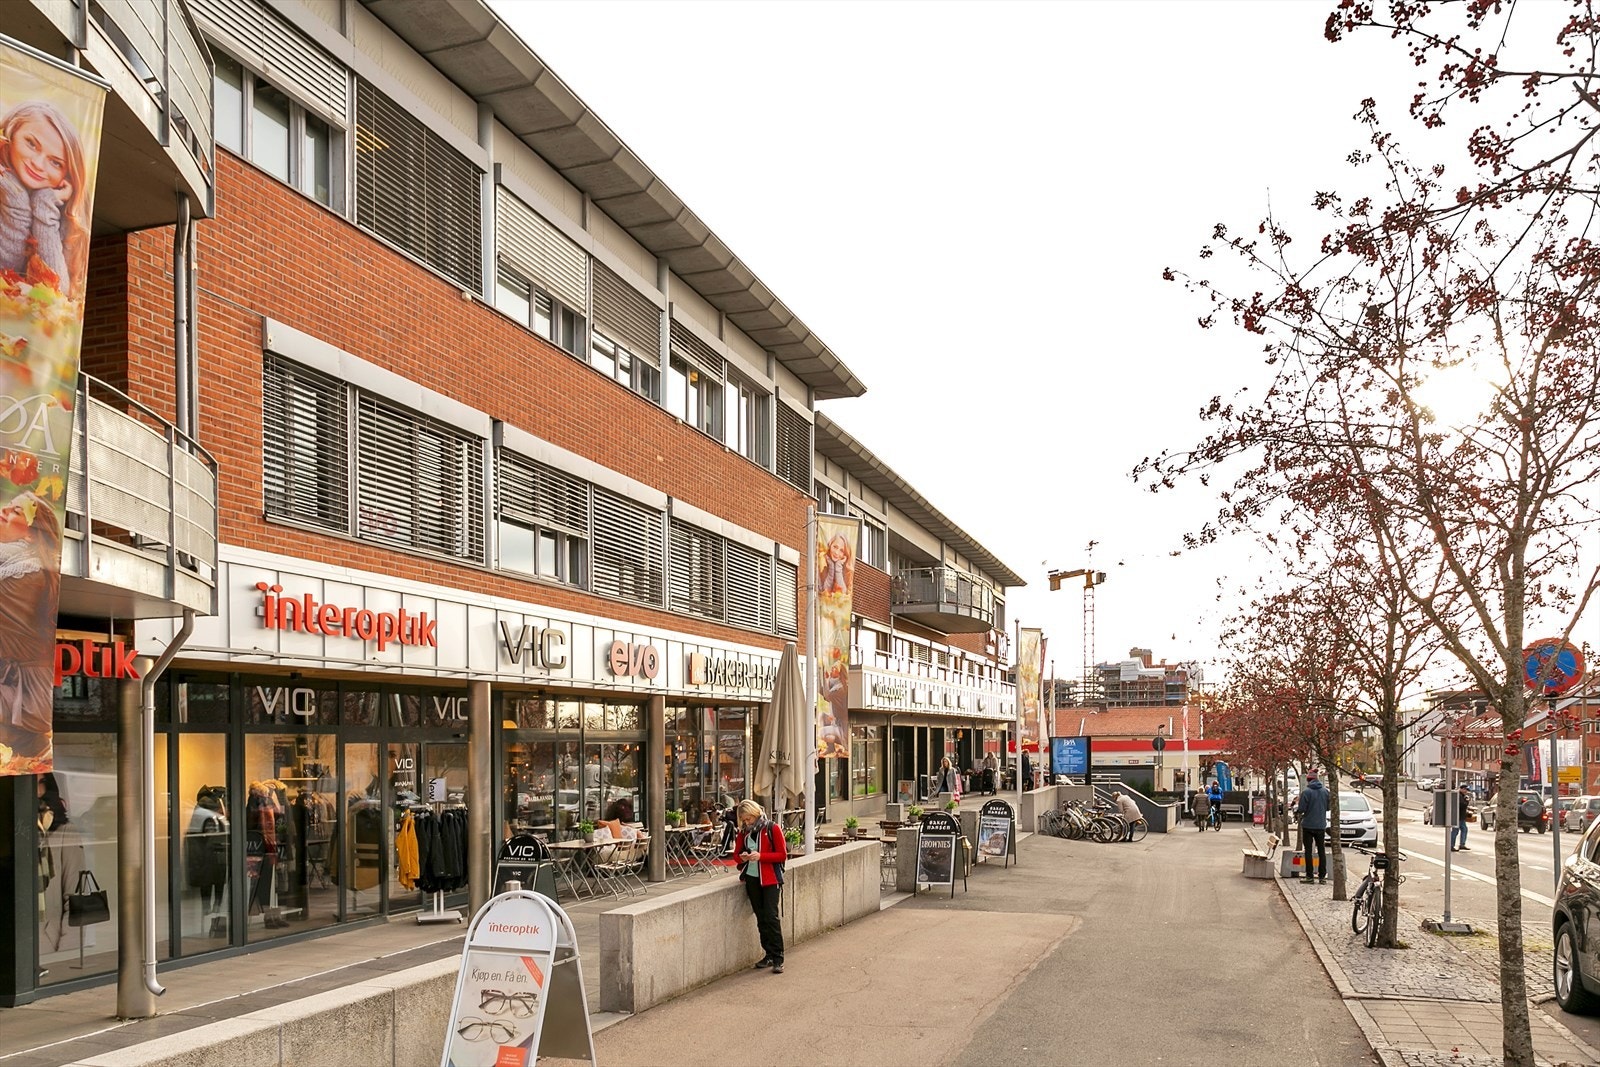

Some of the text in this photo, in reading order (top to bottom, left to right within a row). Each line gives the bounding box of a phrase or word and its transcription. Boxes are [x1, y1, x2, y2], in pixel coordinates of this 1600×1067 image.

[255, 581, 437, 652] interoptik
[500, 620, 567, 670] VIC
[608, 639, 660, 680] evo
[704, 655, 751, 689] BAKER
[256, 685, 316, 716] VIC
[433, 696, 468, 720] VIC
[395, 758, 414, 769] VIC
[508, 845, 534, 857] VIC
[488, 922, 540, 936] interoptik
[471, 968, 490, 983] Kjøp
[504, 969, 516, 983] Få
